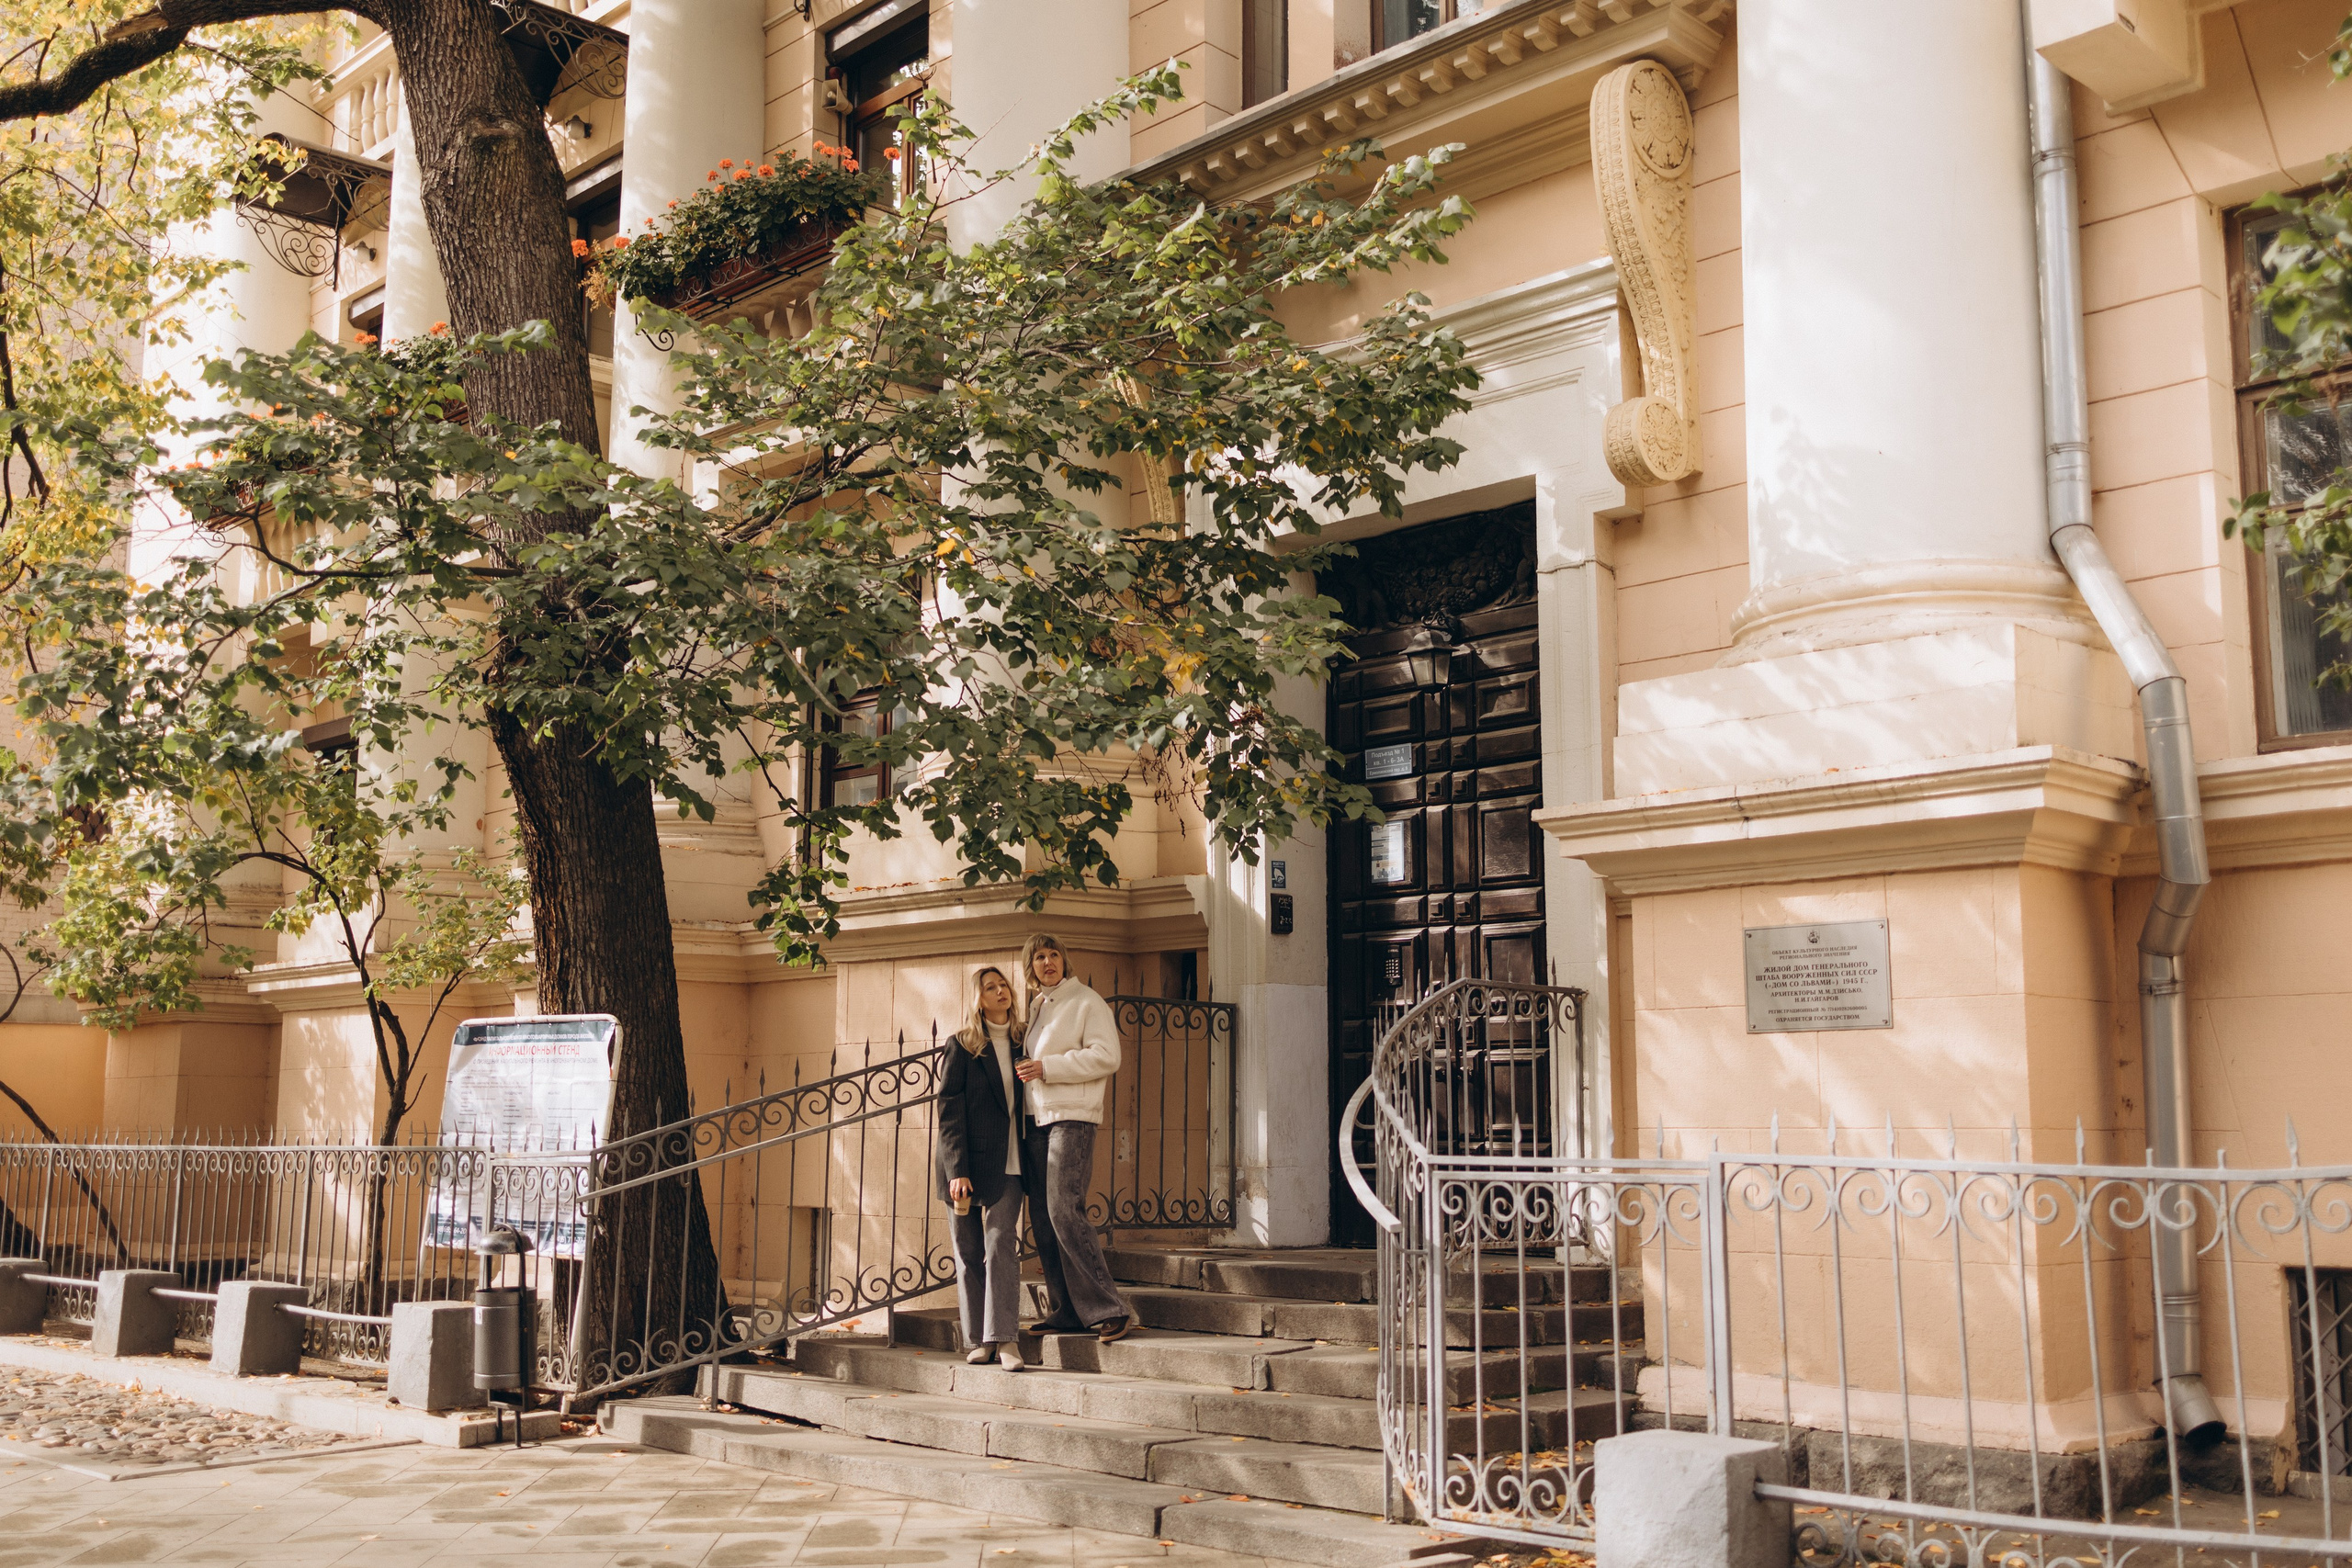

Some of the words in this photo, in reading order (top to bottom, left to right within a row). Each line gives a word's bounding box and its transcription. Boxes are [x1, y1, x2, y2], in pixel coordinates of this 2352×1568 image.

[1764, 965, 1791, 973] ЖИЛОЙ
[1811, 961, 1868, 970] ГЕНЕРАЛЬНОГО
[1782, 971, 1839, 980] ВООРУЖЕННЫХ
[489, 1043, 556, 1056] ИНФОРМАЦИОННЫЙ
[558, 1045, 580, 1057] СТЕНД
